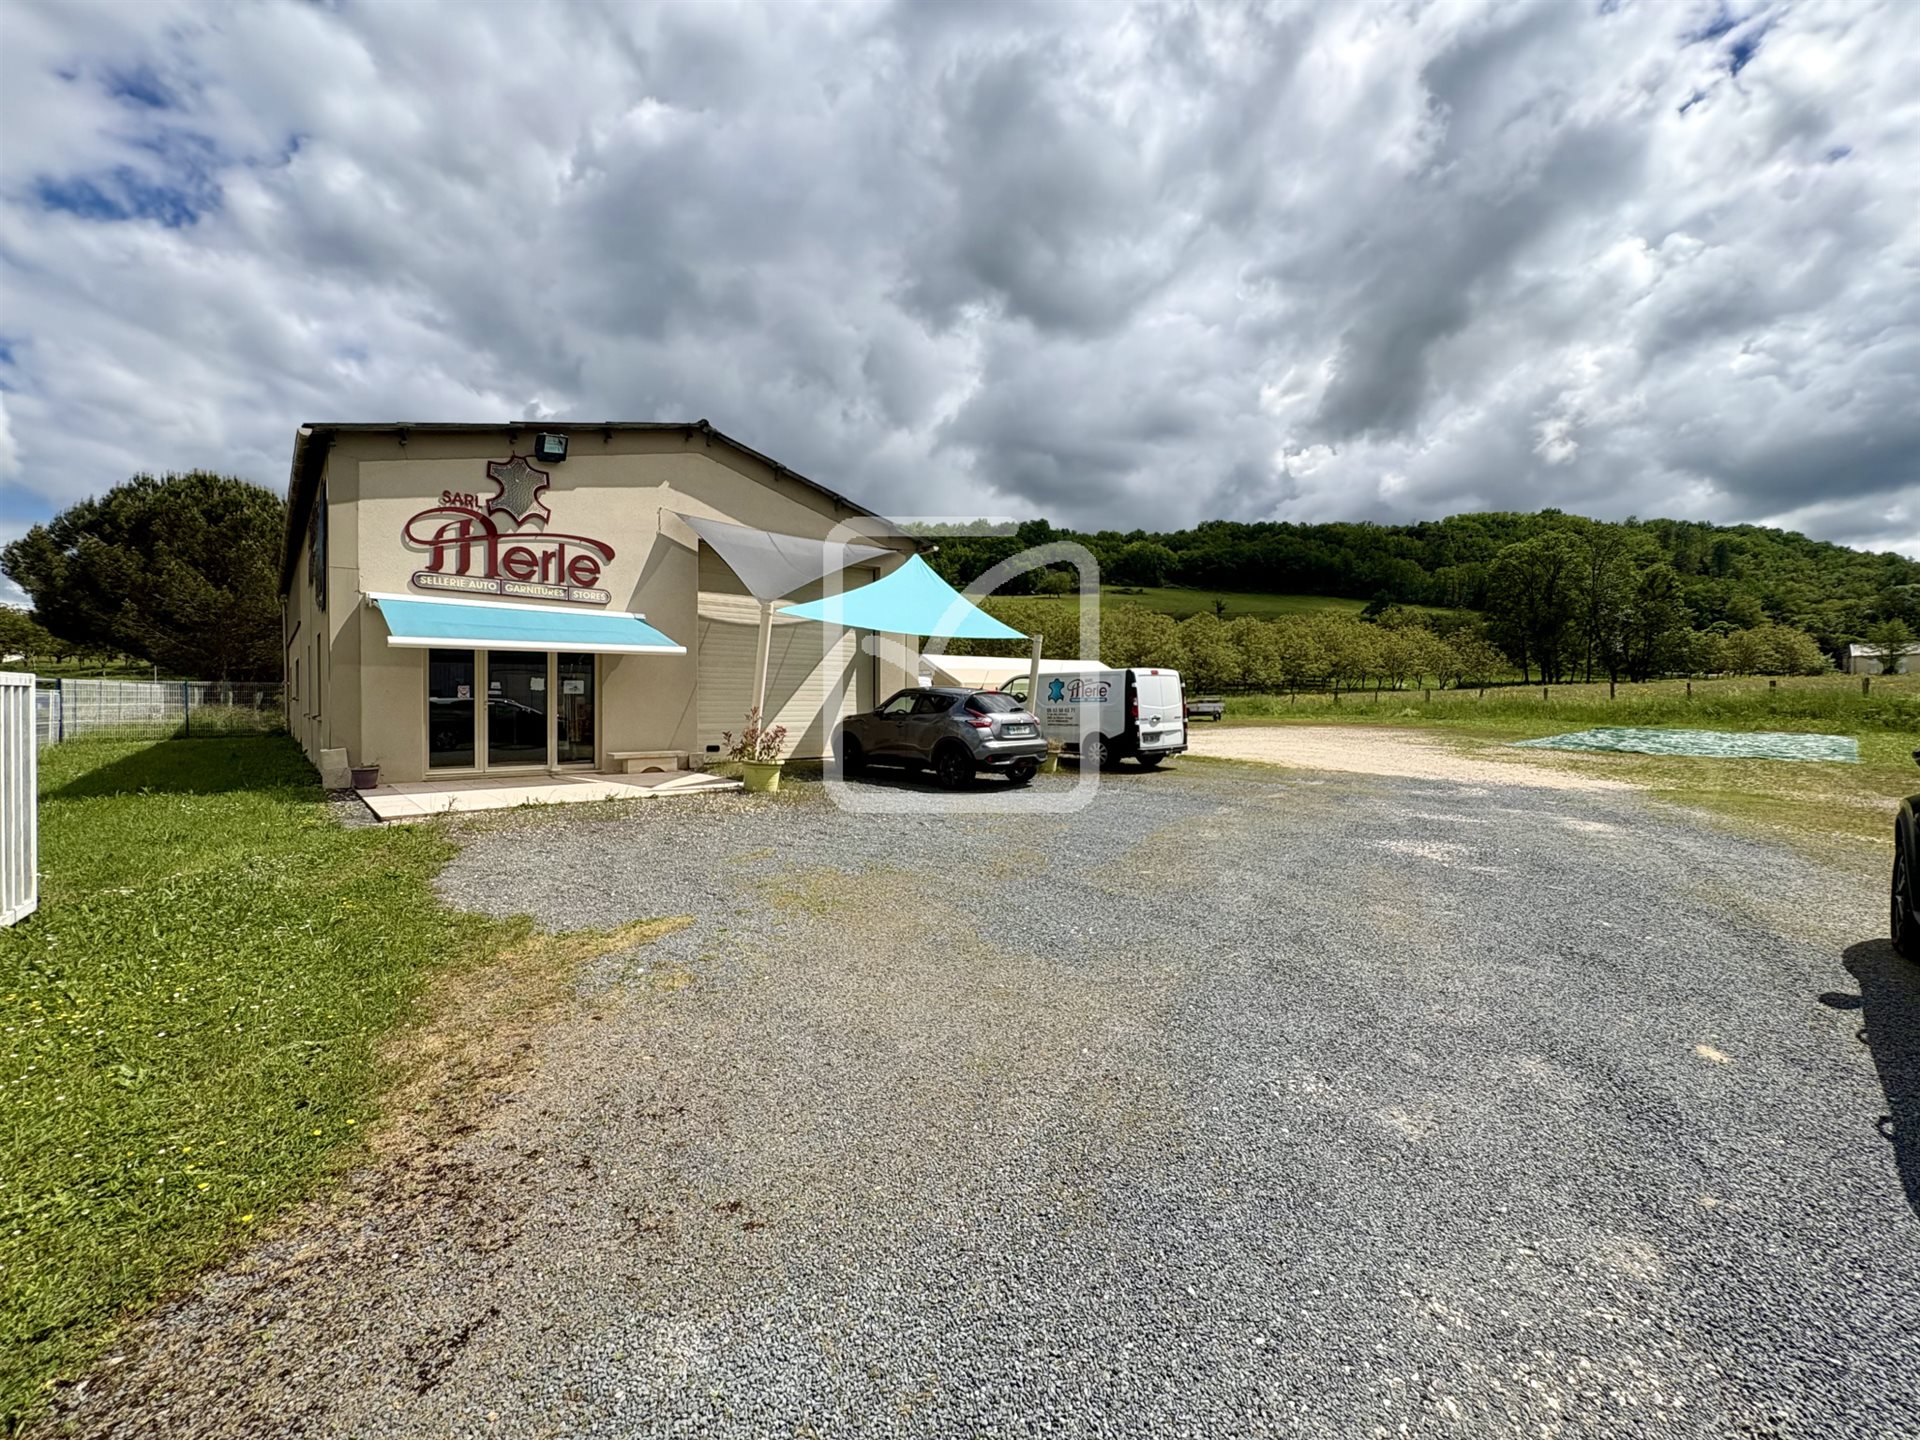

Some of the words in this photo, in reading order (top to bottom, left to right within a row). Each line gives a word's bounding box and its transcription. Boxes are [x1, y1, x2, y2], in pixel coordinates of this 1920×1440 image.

[441, 490, 483, 509] SARL
[404, 506, 616, 588] Merle
[419, 575, 467, 589] SELLERIE
[468, 580, 497, 591] AUTO
[505, 584, 565, 597] GARNITURES
[572, 590, 607, 601] STORES
[1067, 678, 1111, 698] Merle
